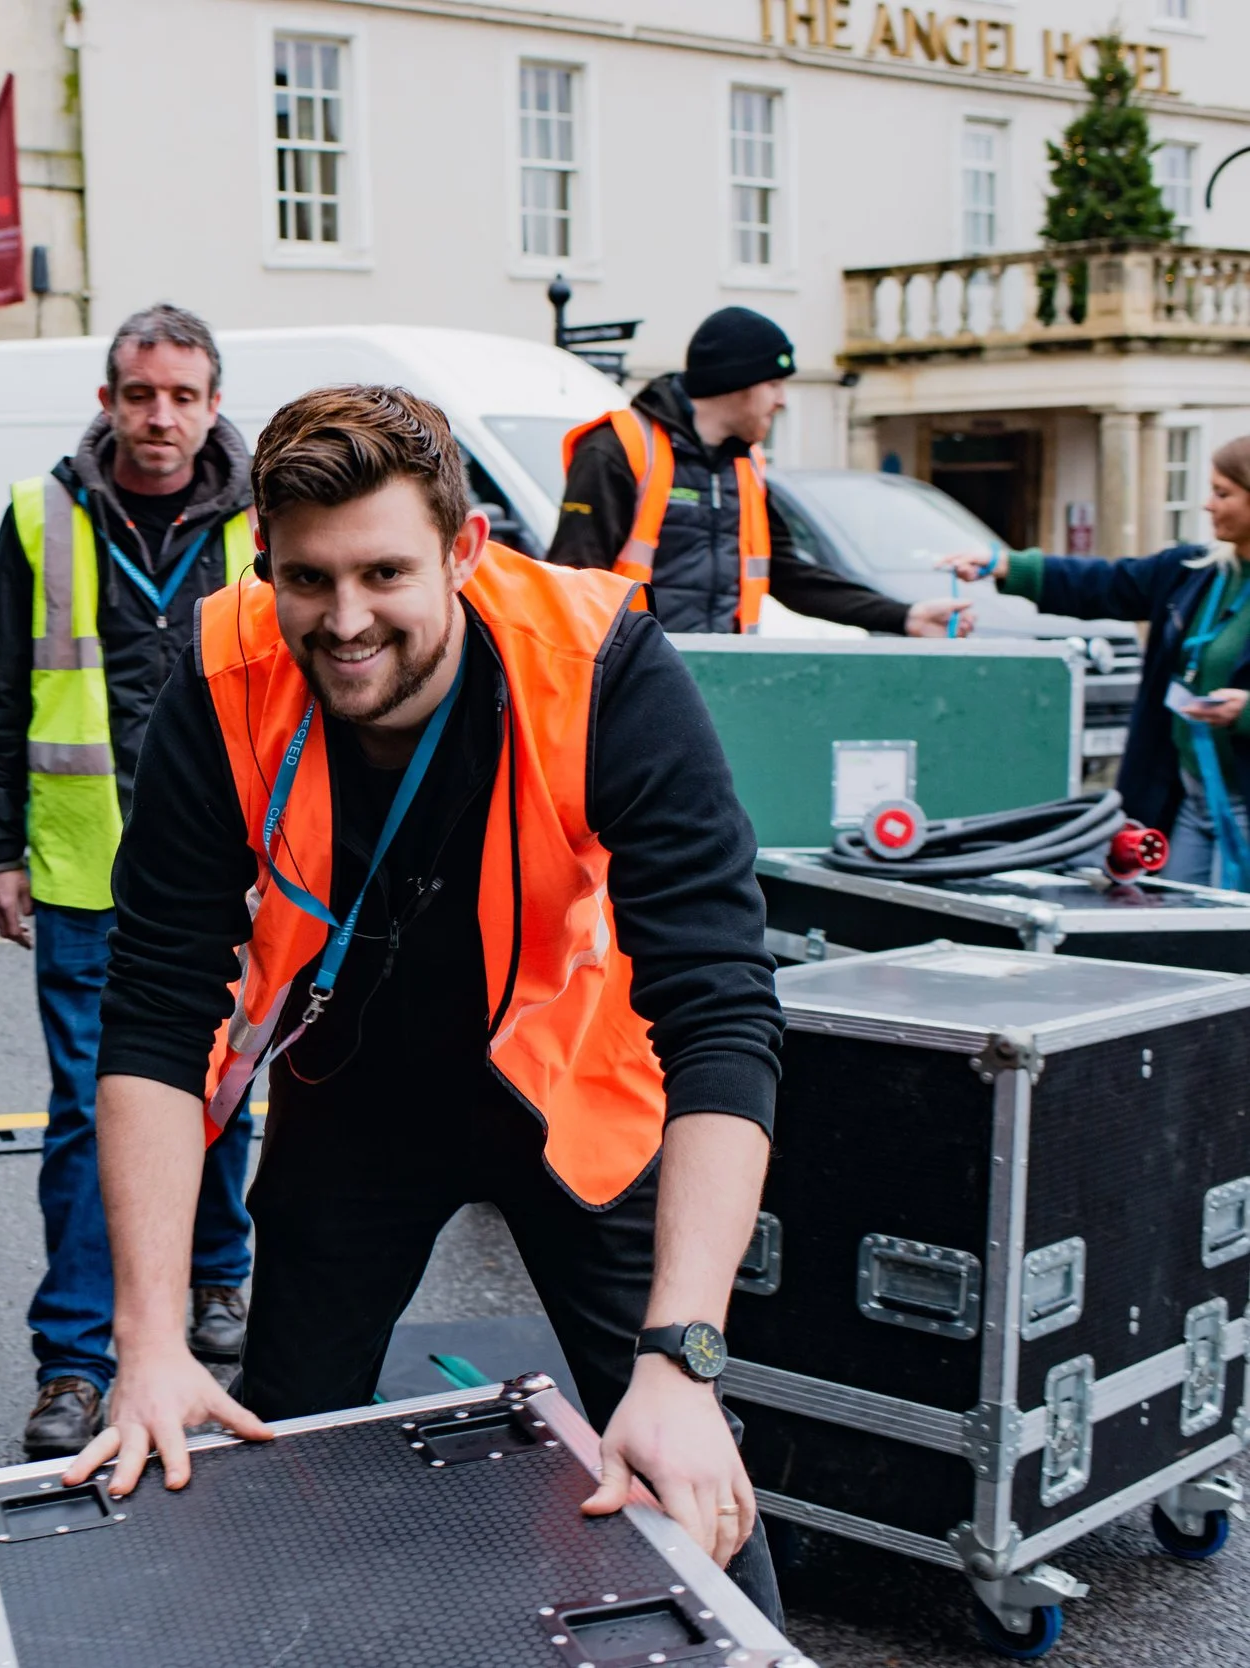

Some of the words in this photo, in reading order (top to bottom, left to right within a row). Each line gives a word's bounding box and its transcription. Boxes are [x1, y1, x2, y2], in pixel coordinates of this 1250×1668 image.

[760, 0, 853, 50] THE
[865, 3, 1031, 75] ANGEL
[286, 703, 315, 766] NECTED
